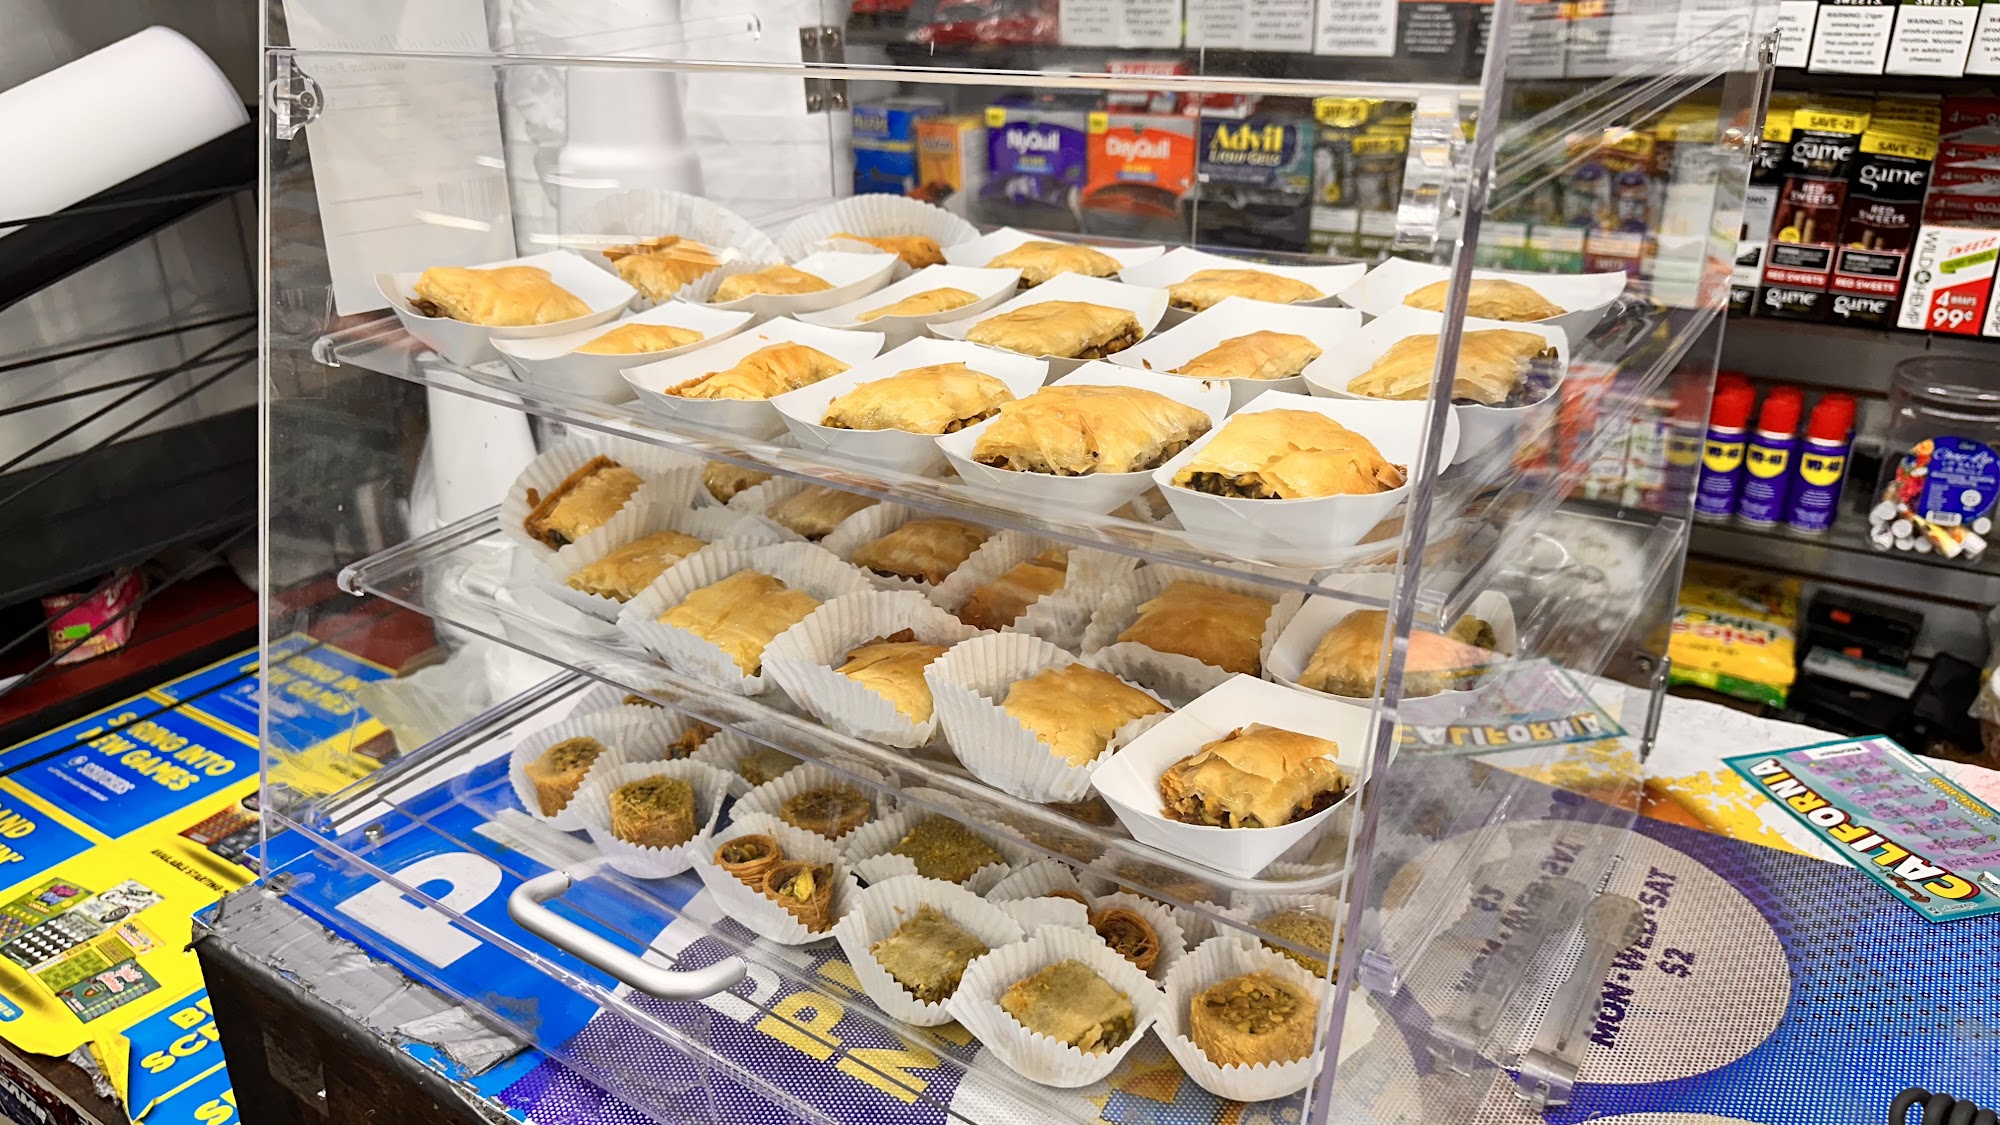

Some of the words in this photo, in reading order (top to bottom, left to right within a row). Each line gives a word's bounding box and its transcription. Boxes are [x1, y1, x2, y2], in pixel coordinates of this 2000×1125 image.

[1007, 128, 1060, 154] NyQuil
[1106, 136, 1171, 162] DayQuil
[1209, 123, 1284, 152] Advil
[1792, 140, 1854, 168] game
[1802, 183, 1826, 195] RED
[1859, 164, 1927, 192] game
[1790, 190, 1835, 205] SWEETS
[1870, 204, 1895, 214] RED
[1859, 210, 1905, 224] SWEETS
[1918, 230, 1941, 270] WILD
[1766, 270, 1786, 280] RED
[1786, 273, 1825, 285] SWEETS
[1834, 277, 1855, 288] RED
[1856, 280, 1896, 293] SWEETS
[1765, 287, 1817, 311] game
[1833, 295, 1889, 319] game
[1906, 283, 1925, 325] HEMP
[1936, 290, 1951, 307] 4
[1950, 295, 1978, 307] WRAPS
[1933, 306, 1975, 328] 99¢
[1708, 446, 1740, 458] WD-40
[1751, 450, 1783, 465] WD-40
[1805, 458, 1841, 472] WD-40
[107, 711, 189, 753] SRING
[173, 743, 236, 777] INTO
[120, 749, 200, 792] GAMES
[1748, 757, 1981, 900] CALIFORNIA
[1655, 947, 1696, 979] $2
